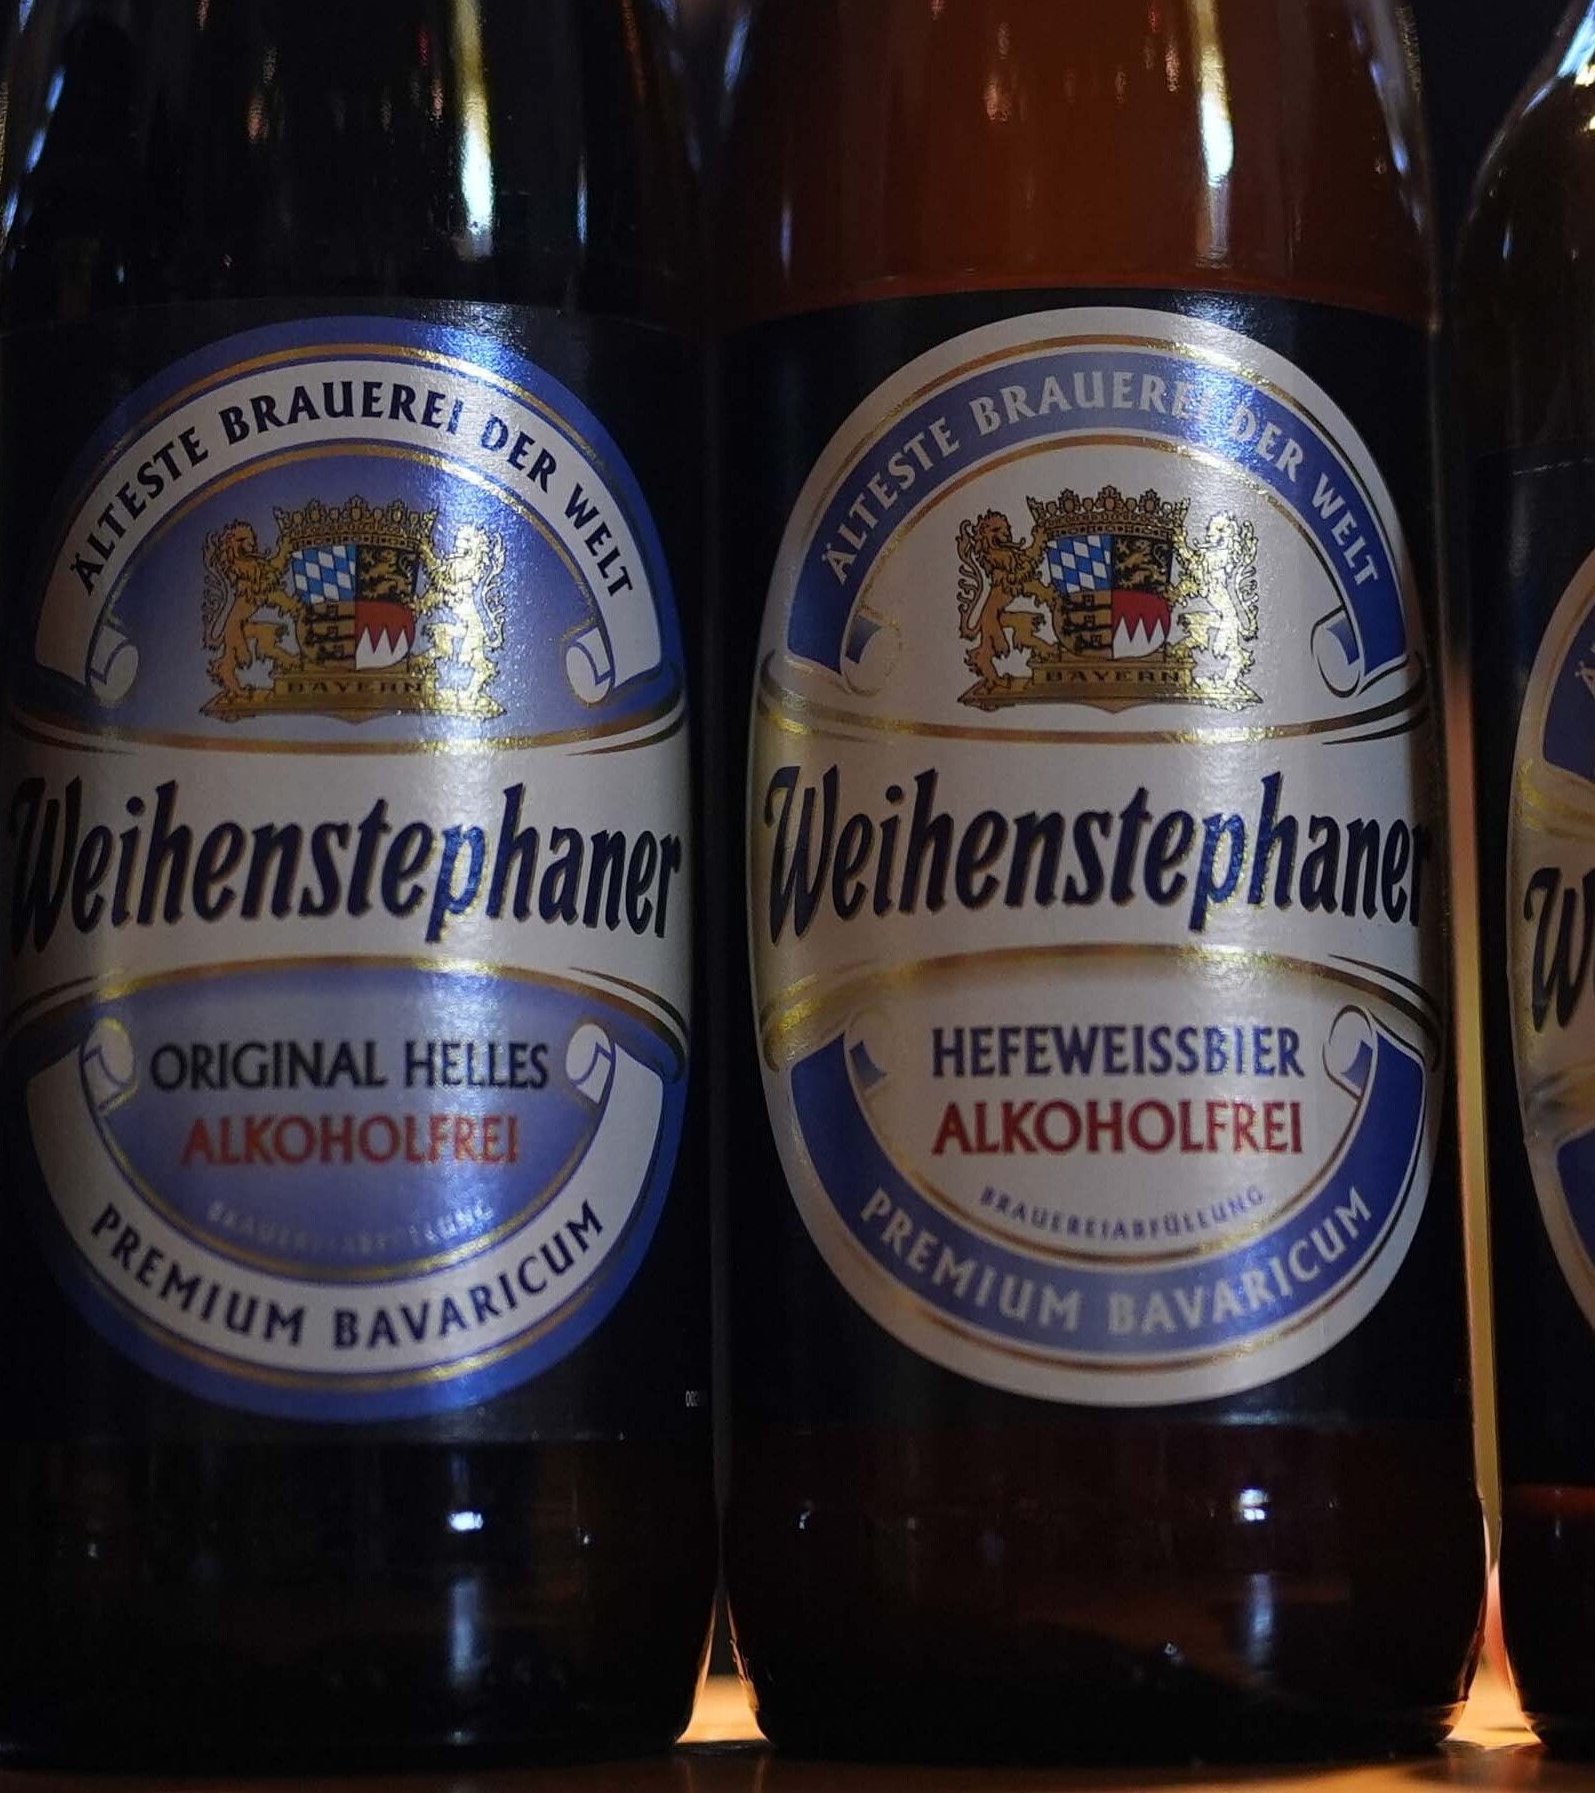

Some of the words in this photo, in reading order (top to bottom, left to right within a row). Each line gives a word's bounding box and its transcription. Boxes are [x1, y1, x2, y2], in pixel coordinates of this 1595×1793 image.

[70, 426, 210, 596] ÄLTESTE
[219, 380, 464, 445] BRAUEREI
[480, 413, 559, 495] DER
[566, 483, 633, 598] WELT
[820, 416, 960, 587] ÄLTESTE
[972, 370, 1209, 436] BRAUEREI
[1226, 403, 1306, 483] DER
[1310, 471, 1381, 585] WELT
[1045, 669, 1180, 684] BAYERN
[12, 775, 681, 956] Weihenstephaner
[763, 764, 1432, 944] Weihenstephaner
[150, 1041, 387, 1090] ORIGINAL
[405, 1043, 548, 1090] HELLES
[931, 1025, 1305, 1079] HEFEWEISSBIER
[181, 1114, 518, 1167] ALKOHOLFREI
[931, 1099, 1304, 1156] ALKOHOLFREI
[859, 1187, 1081, 1333] PREMIUM
[1107, 1186, 1372, 1336] BAVARICUM
[979, 1184, 1267, 1241] BRAUEREIABFÜLLUNG
[91, 1202, 305, 1349] PREMIUM
[333, 1199, 606, 1350] BAVARICUM
